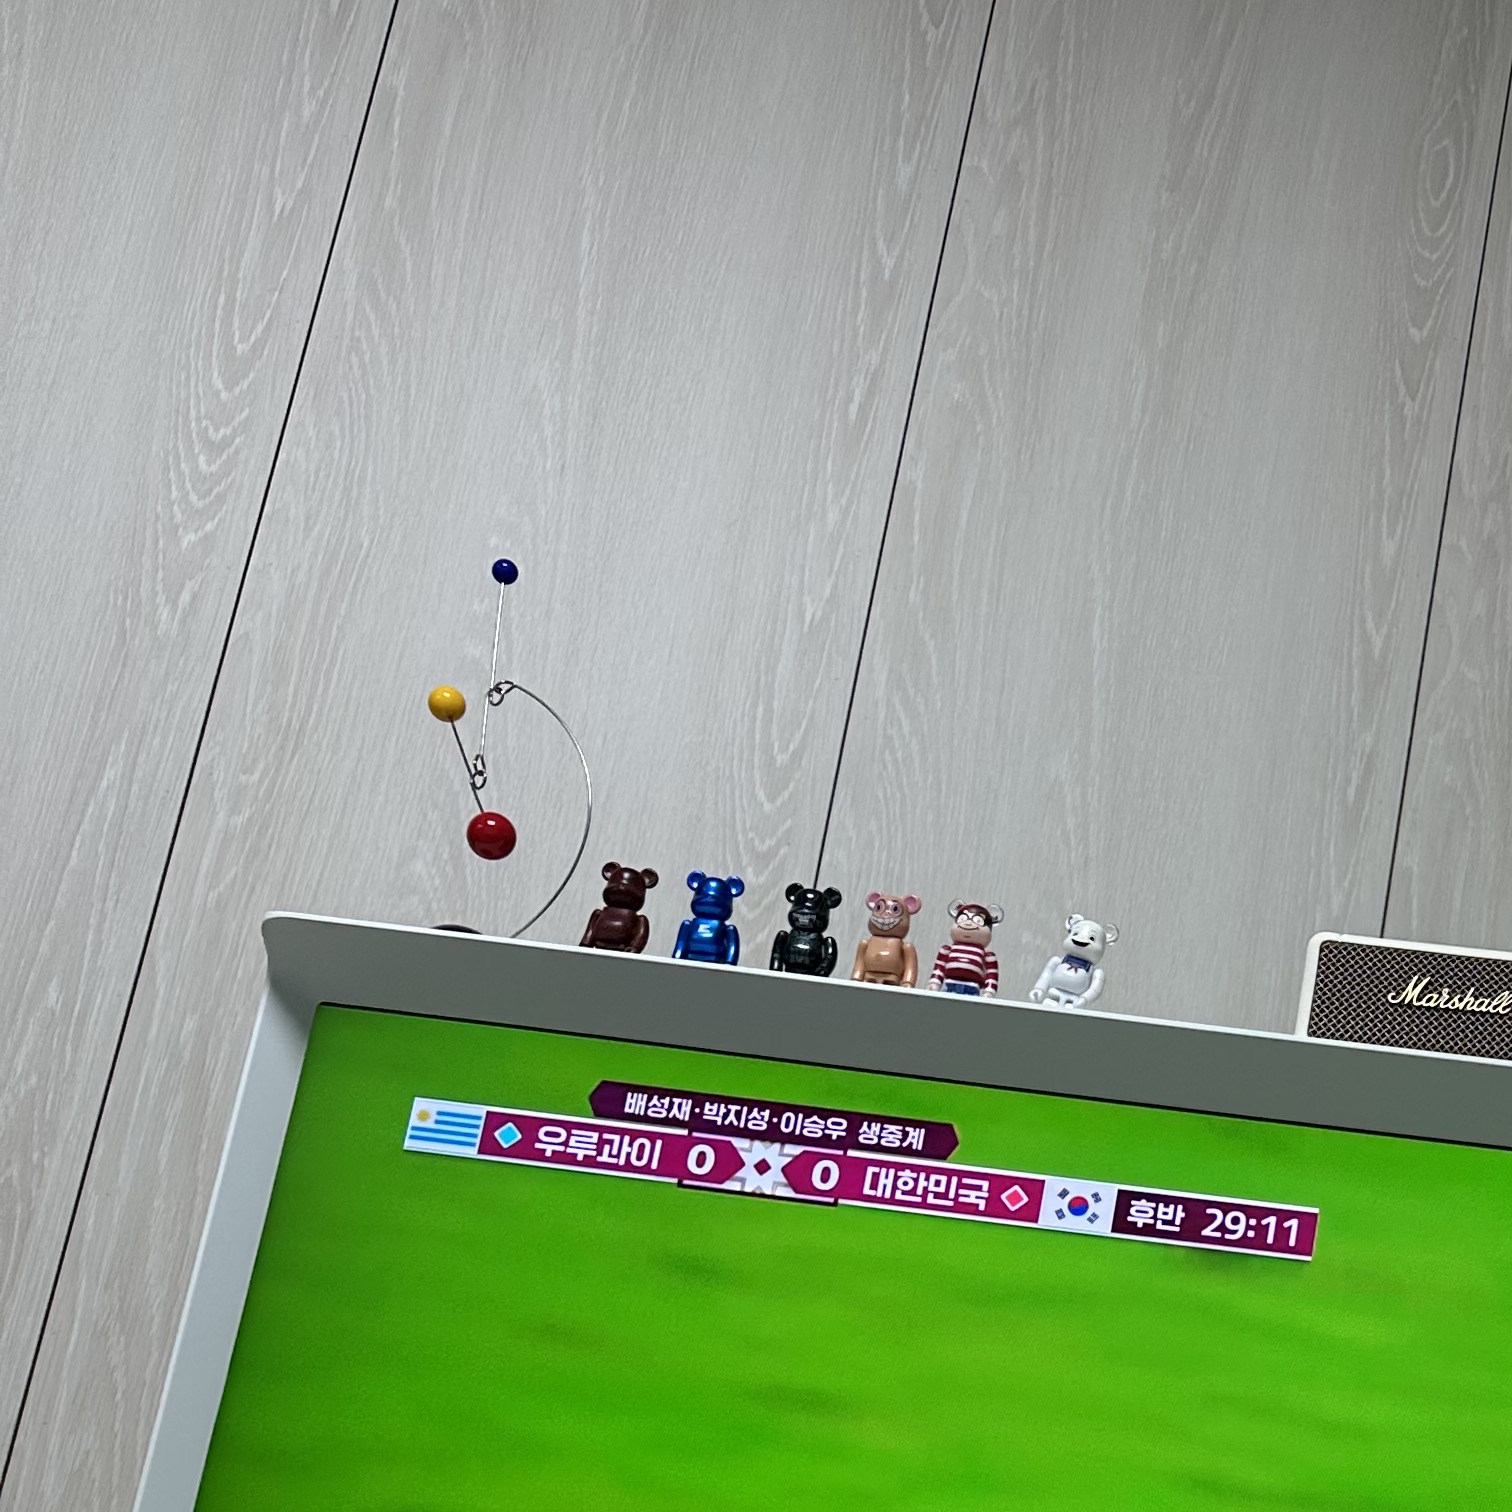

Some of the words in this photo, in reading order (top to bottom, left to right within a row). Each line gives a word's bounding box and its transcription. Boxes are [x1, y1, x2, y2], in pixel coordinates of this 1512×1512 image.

[858, 1121, 926, 1150] 생중계
[534, 1125, 662, 1170] 우루과이
[687, 1144, 716, 1175] 0
[811, 1159, 840, 1191] 0
[862, 1166, 990, 1211] 대한민국
[1126, 1199, 1186, 1232] 후반
[1200, 1207, 1300, 1247] 29:11
